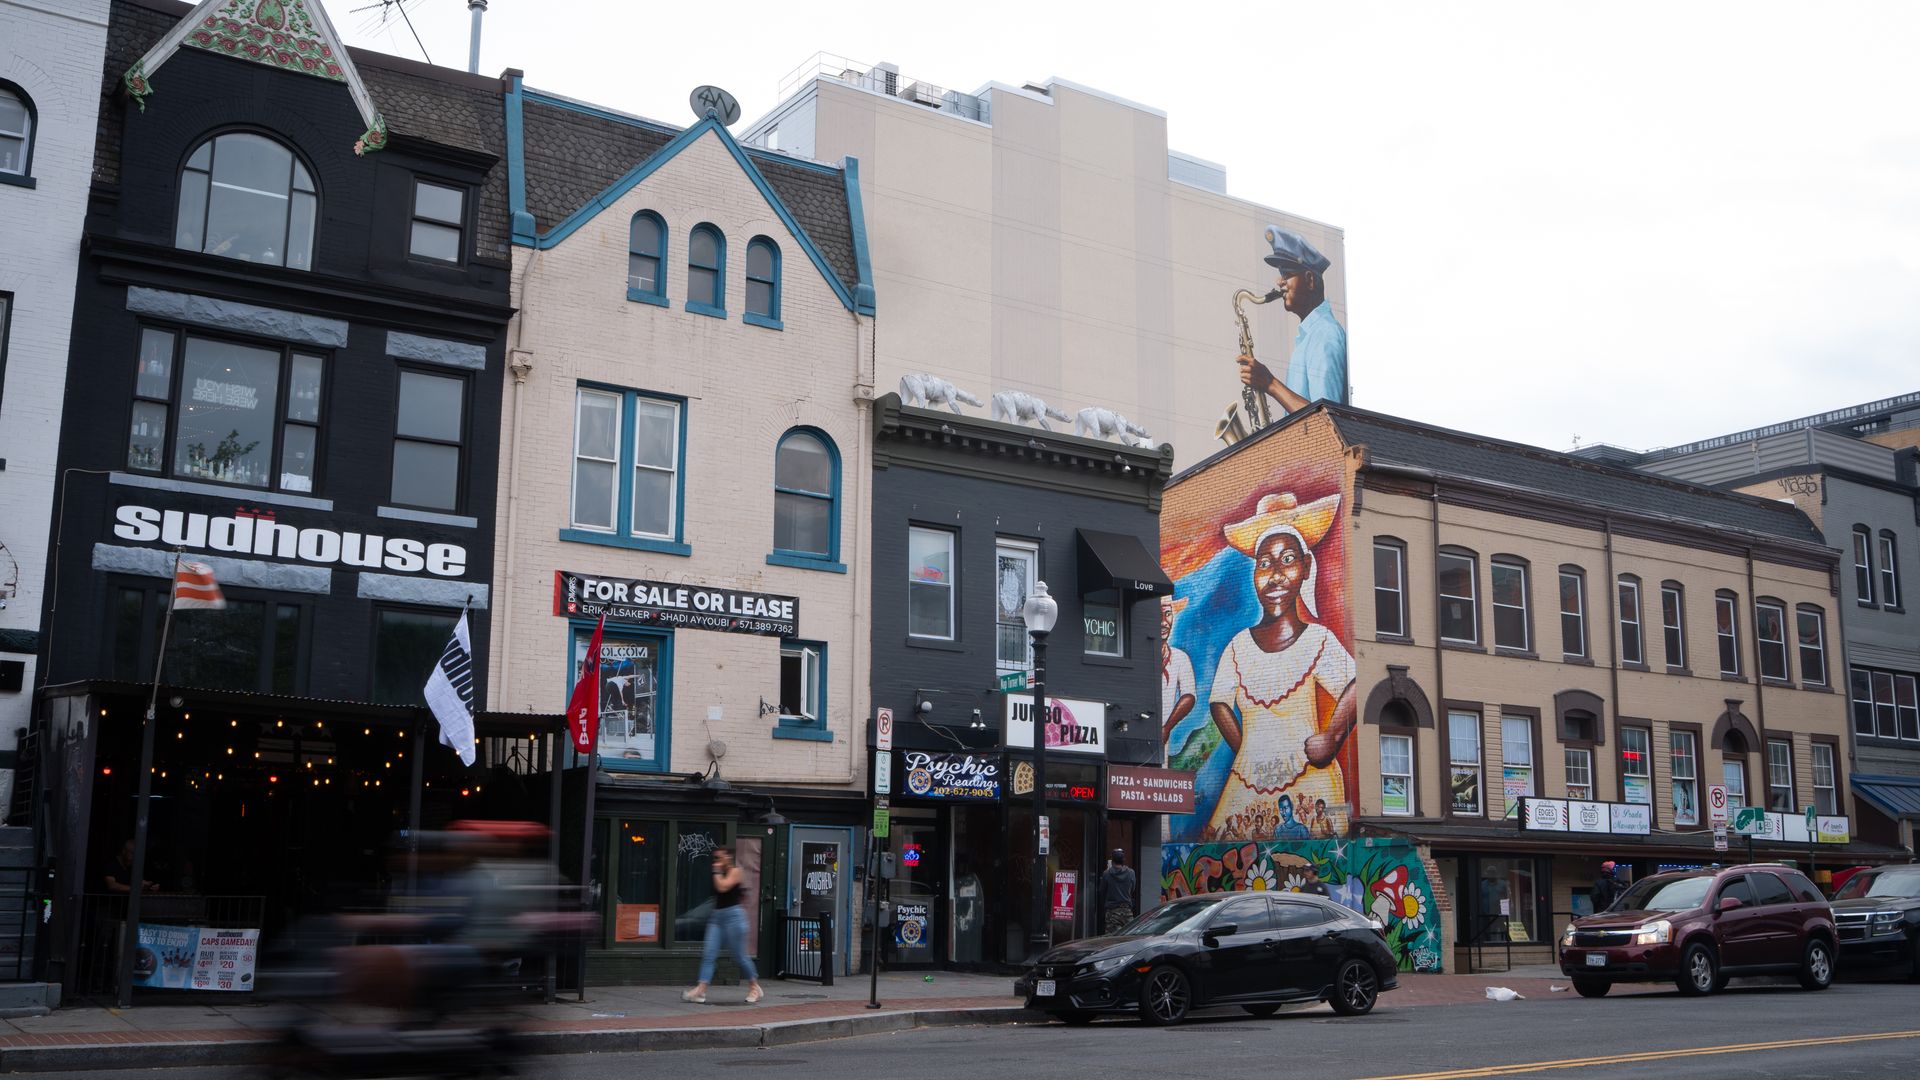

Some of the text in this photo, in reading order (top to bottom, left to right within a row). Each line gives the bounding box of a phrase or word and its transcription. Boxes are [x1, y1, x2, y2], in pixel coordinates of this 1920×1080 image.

[114, 505, 466, 576] sudhouse
[1134, 580, 1154, 591] Love
[583, 579, 794, 619] FOR SALE OR LEASE
[582, 605, 604, 615] ERIK
[660, 612, 688, 622] SHADI
[690, 614, 730, 627] AYYOUBI
[739, 621, 793, 634] 571.389.7362
[1083, 617, 1115, 637] YCHIC
[601, 647, 646, 657] OLCOM
[1060, 724, 1099, 745] PIZZA
[905, 752, 999, 779] Psychic
[942, 773, 998, 791] Readings
[1111, 775, 1135, 786] PIZZA
[1143, 777, 1193, 790] SANDWICHES
[1070, 786, 1094, 798] OPEN
[1121, 790, 1145, 801] PASTA
[1152, 792, 1184, 803] SALADS
[1538, 808, 1554, 817] EDGES
[806, 871, 833, 890] CRUSHED
[897, 905, 927, 915] Psychic
[139, 929, 156, 937] EASY
[139, 937, 155, 945] EASY
[221, 938, 256, 946] GAMEDAY!
